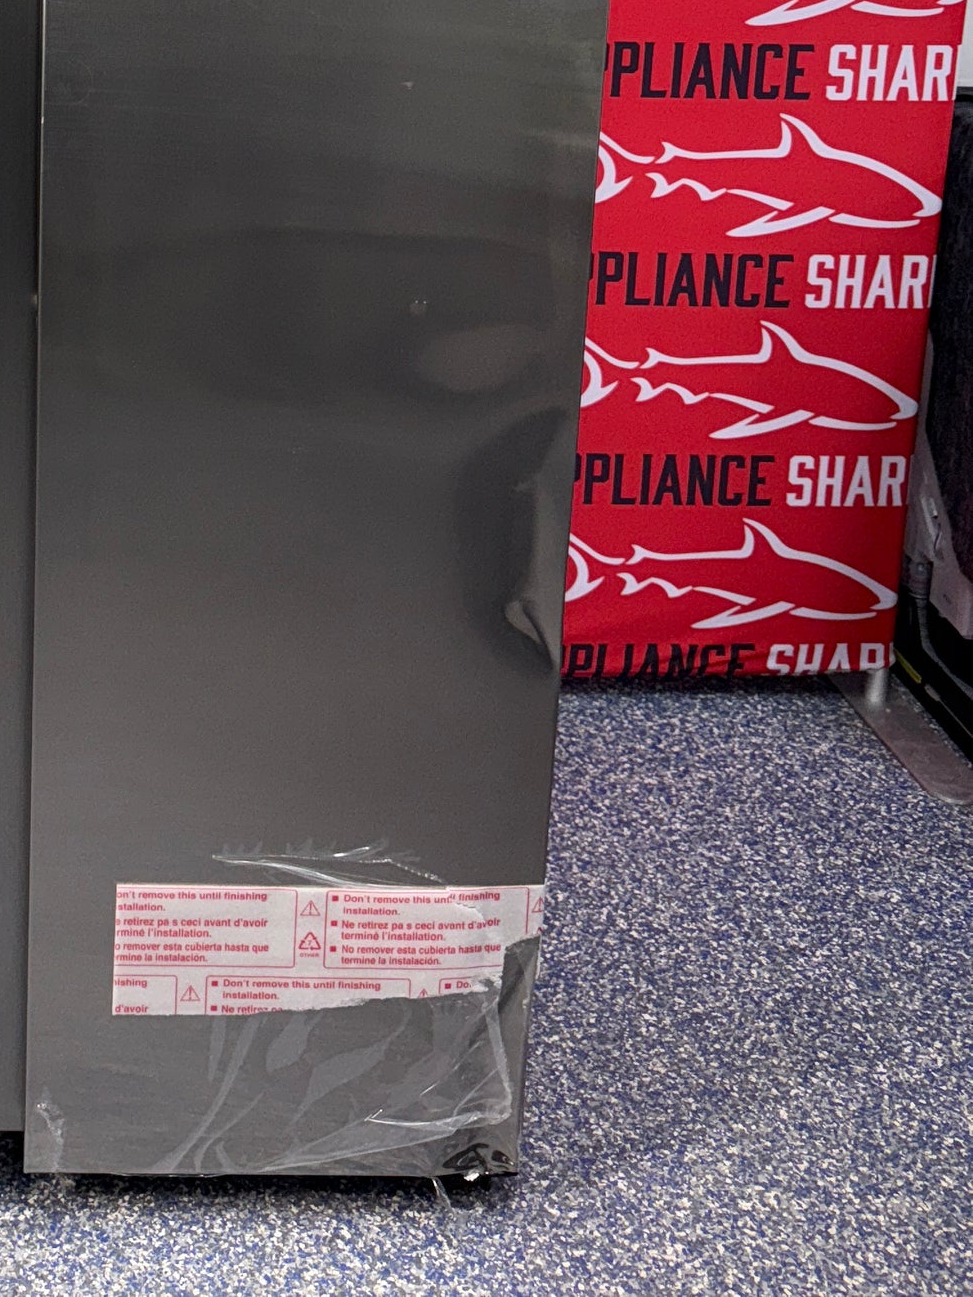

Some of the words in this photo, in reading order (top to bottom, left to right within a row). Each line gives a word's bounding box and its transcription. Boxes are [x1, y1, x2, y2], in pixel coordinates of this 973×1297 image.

[603, 41, 816, 101] PLIANCE
[825, 43, 961, 102] SHAR
[589, 251, 794, 308] PLIANCE
[804, 253, 936, 309] SHAR
[573, 452, 775, 507] PLIANCE
[785, 455, 912, 507] SHAR
[766, 643, 896, 674] SHAR
[116, 891, 136, 900] on't
[138, 892, 175, 900] remove
[177, 891, 196, 900] this
[199, 892, 221, 900] until
[224, 892, 268, 901] finishing
